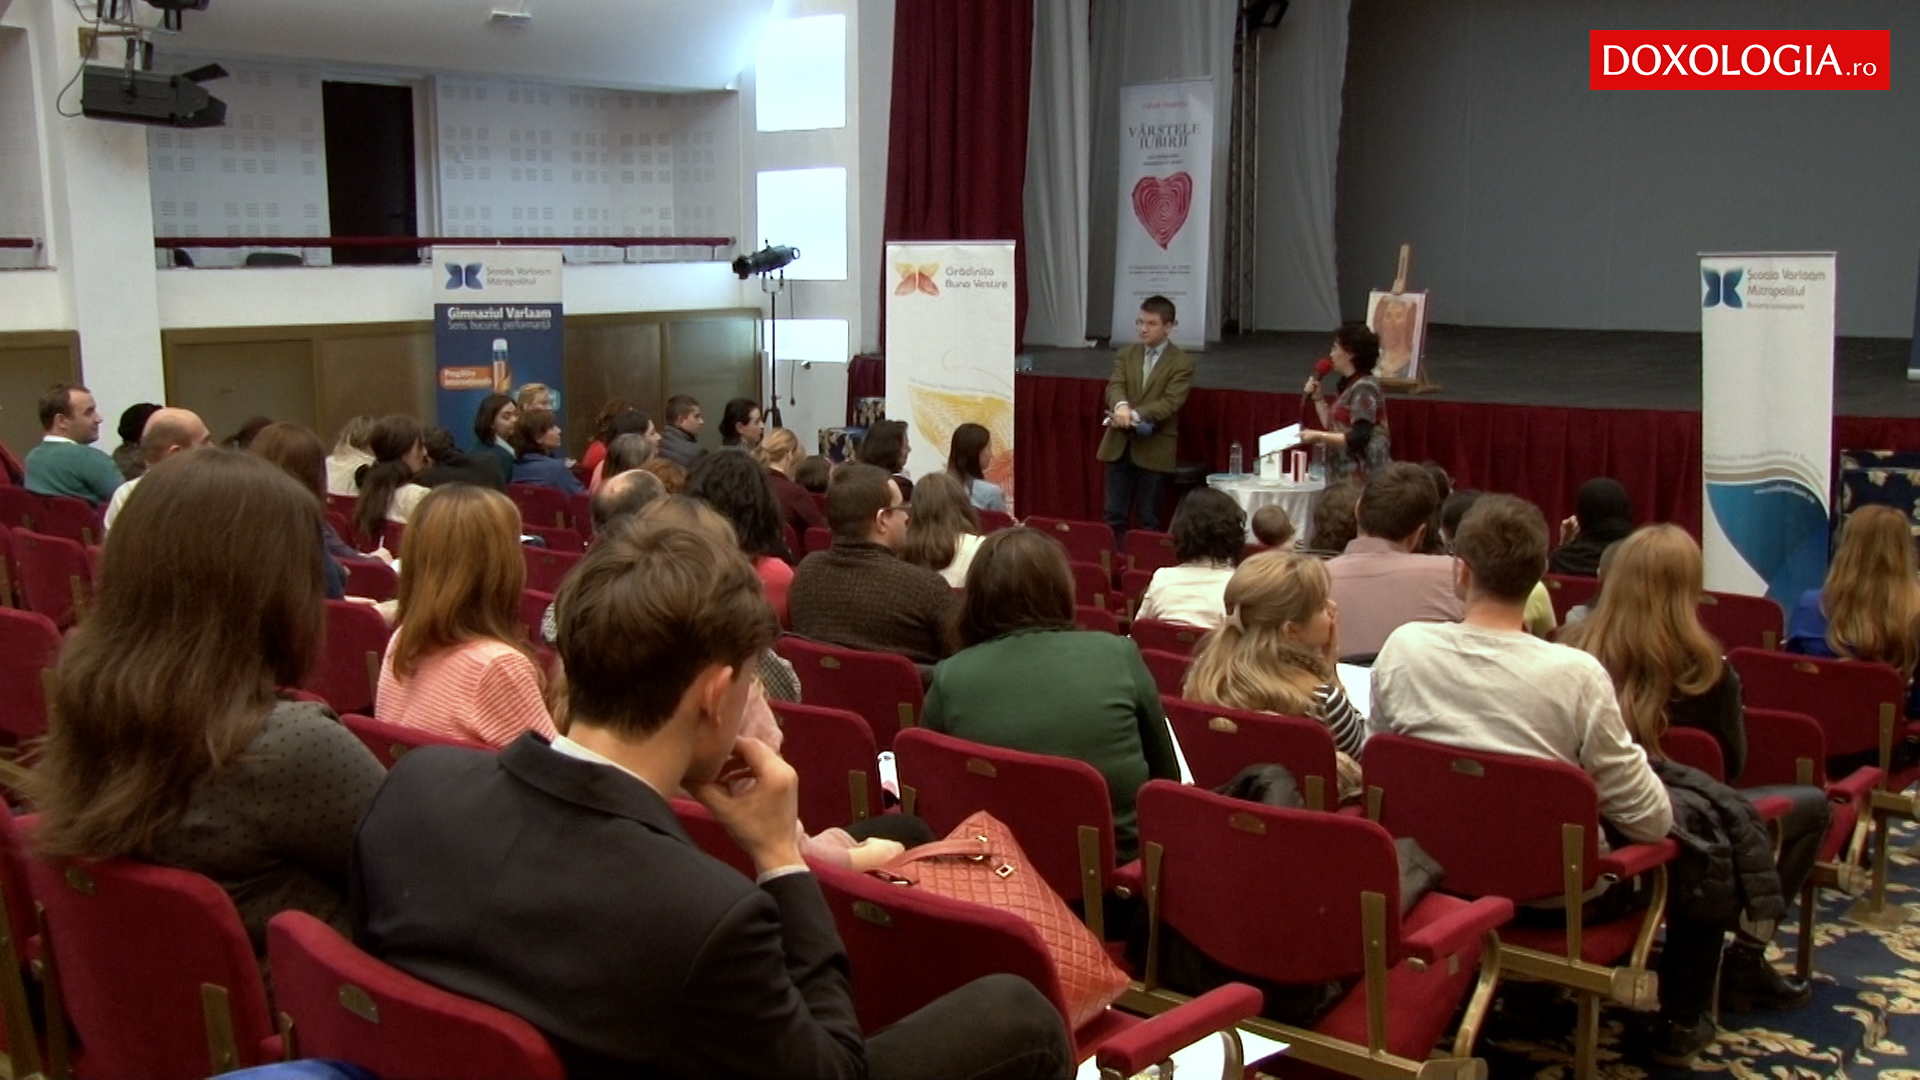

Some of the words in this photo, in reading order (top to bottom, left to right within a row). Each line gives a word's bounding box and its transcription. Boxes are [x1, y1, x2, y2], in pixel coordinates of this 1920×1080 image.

[1782, 268, 1825, 281] Varlaam
[447, 307, 503, 319] Gimnaziul
[505, 307, 552, 319] Varlaam
